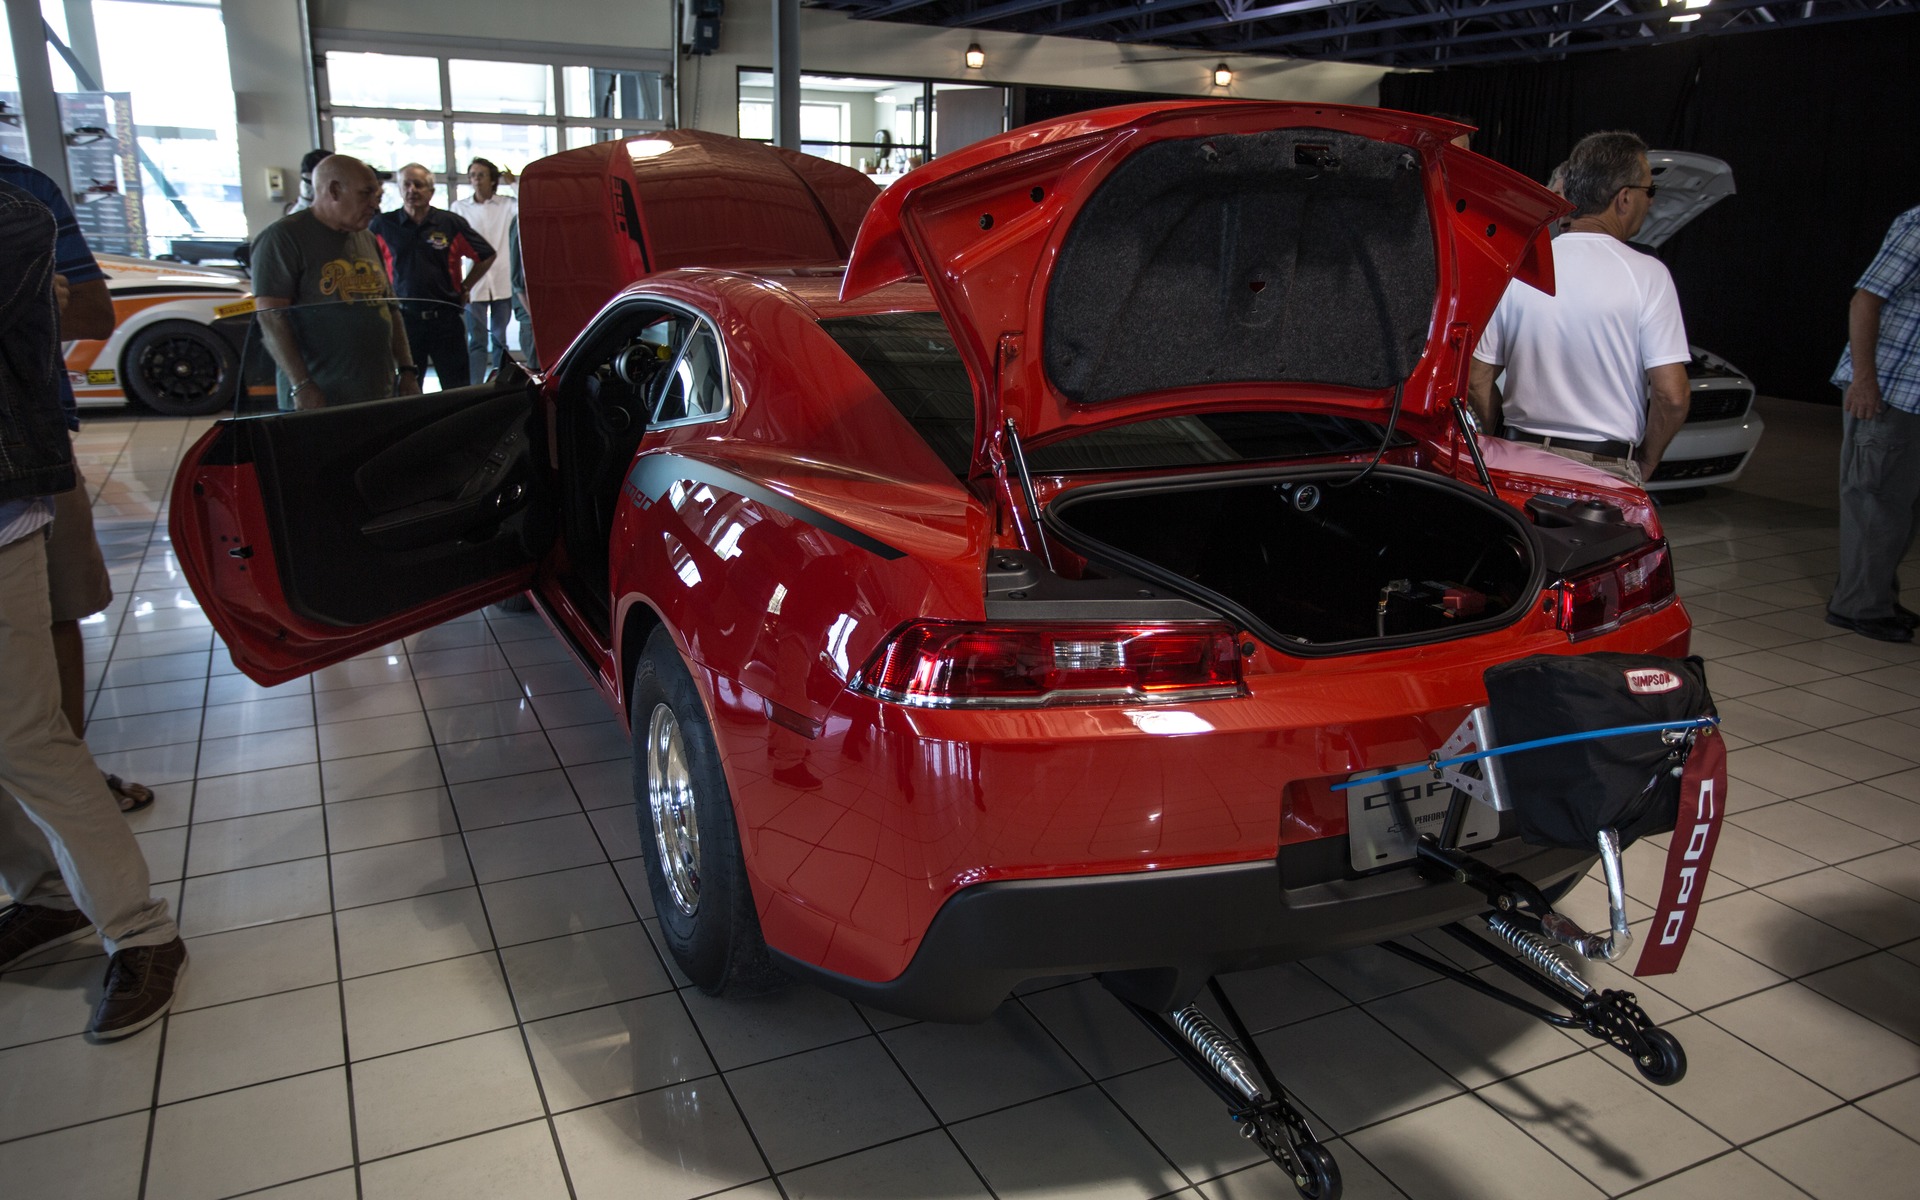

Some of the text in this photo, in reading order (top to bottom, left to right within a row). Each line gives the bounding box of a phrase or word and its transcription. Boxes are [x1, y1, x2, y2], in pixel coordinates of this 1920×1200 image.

[1631, 672, 1671, 688] SIMPSON
[1363, 781, 1453, 811] COP
[1660, 779, 1714, 945] COPO
